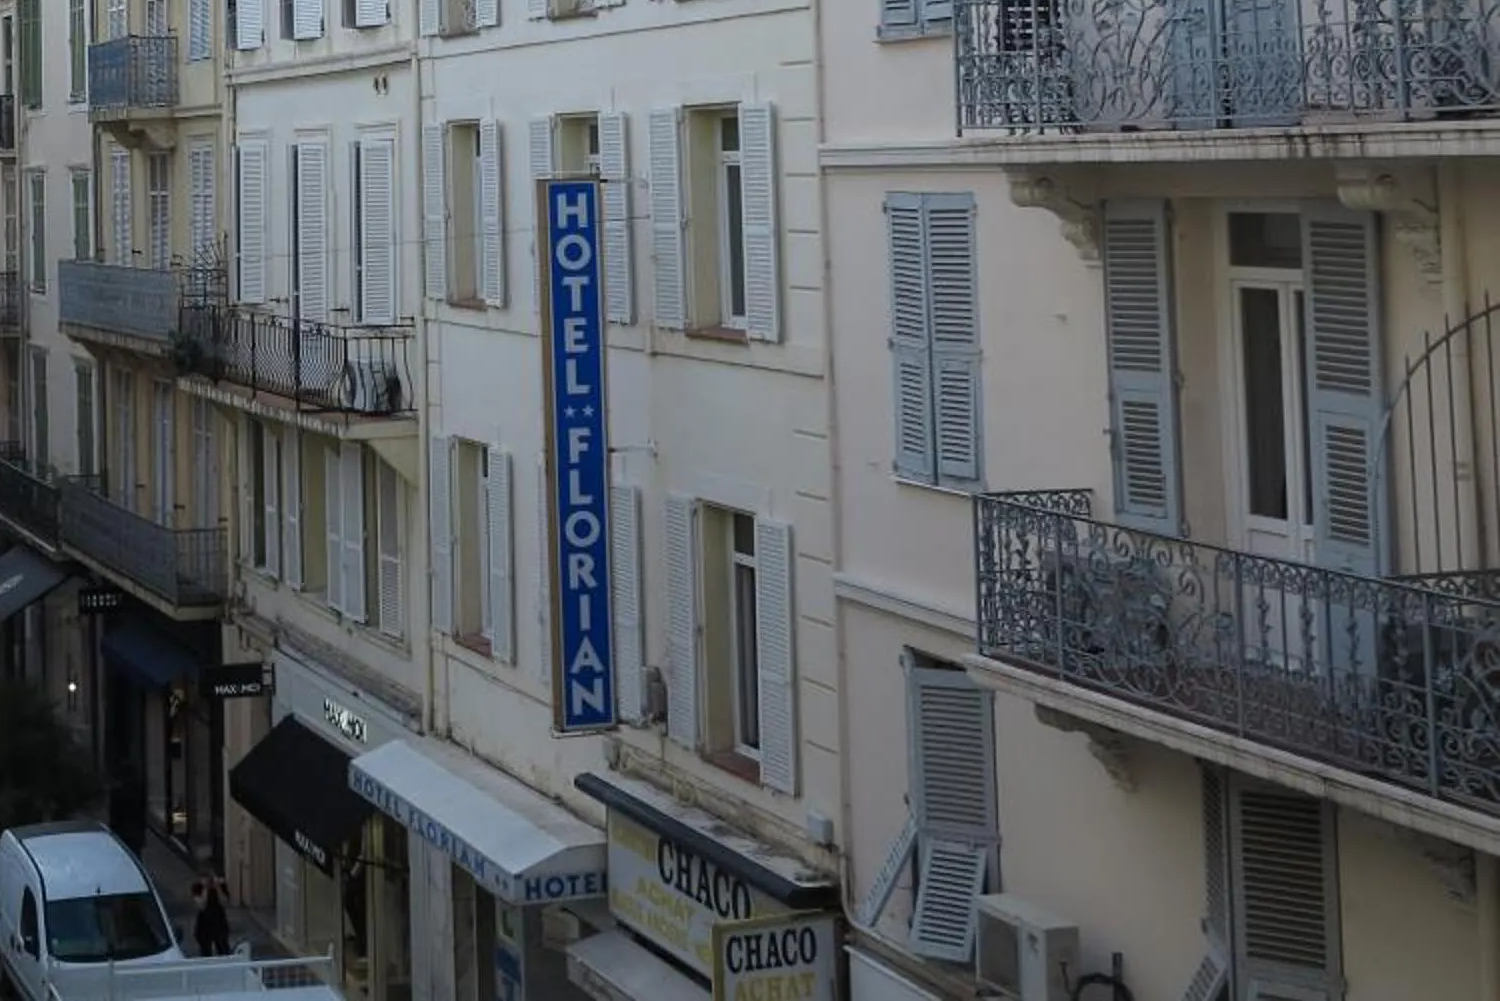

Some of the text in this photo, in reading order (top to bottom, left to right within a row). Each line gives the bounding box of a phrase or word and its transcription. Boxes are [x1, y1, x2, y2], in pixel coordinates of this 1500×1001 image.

[556, 193, 604, 716] HOTEL FLORIAN
[214, 683, 237, 696] MAX
[353, 773, 485, 878] HOTEL FLORIAN
[657, 837, 752, 920] CHACO
[725, 926, 818, 975] CHACO
[734, 971, 817, 1001] ACHAT
